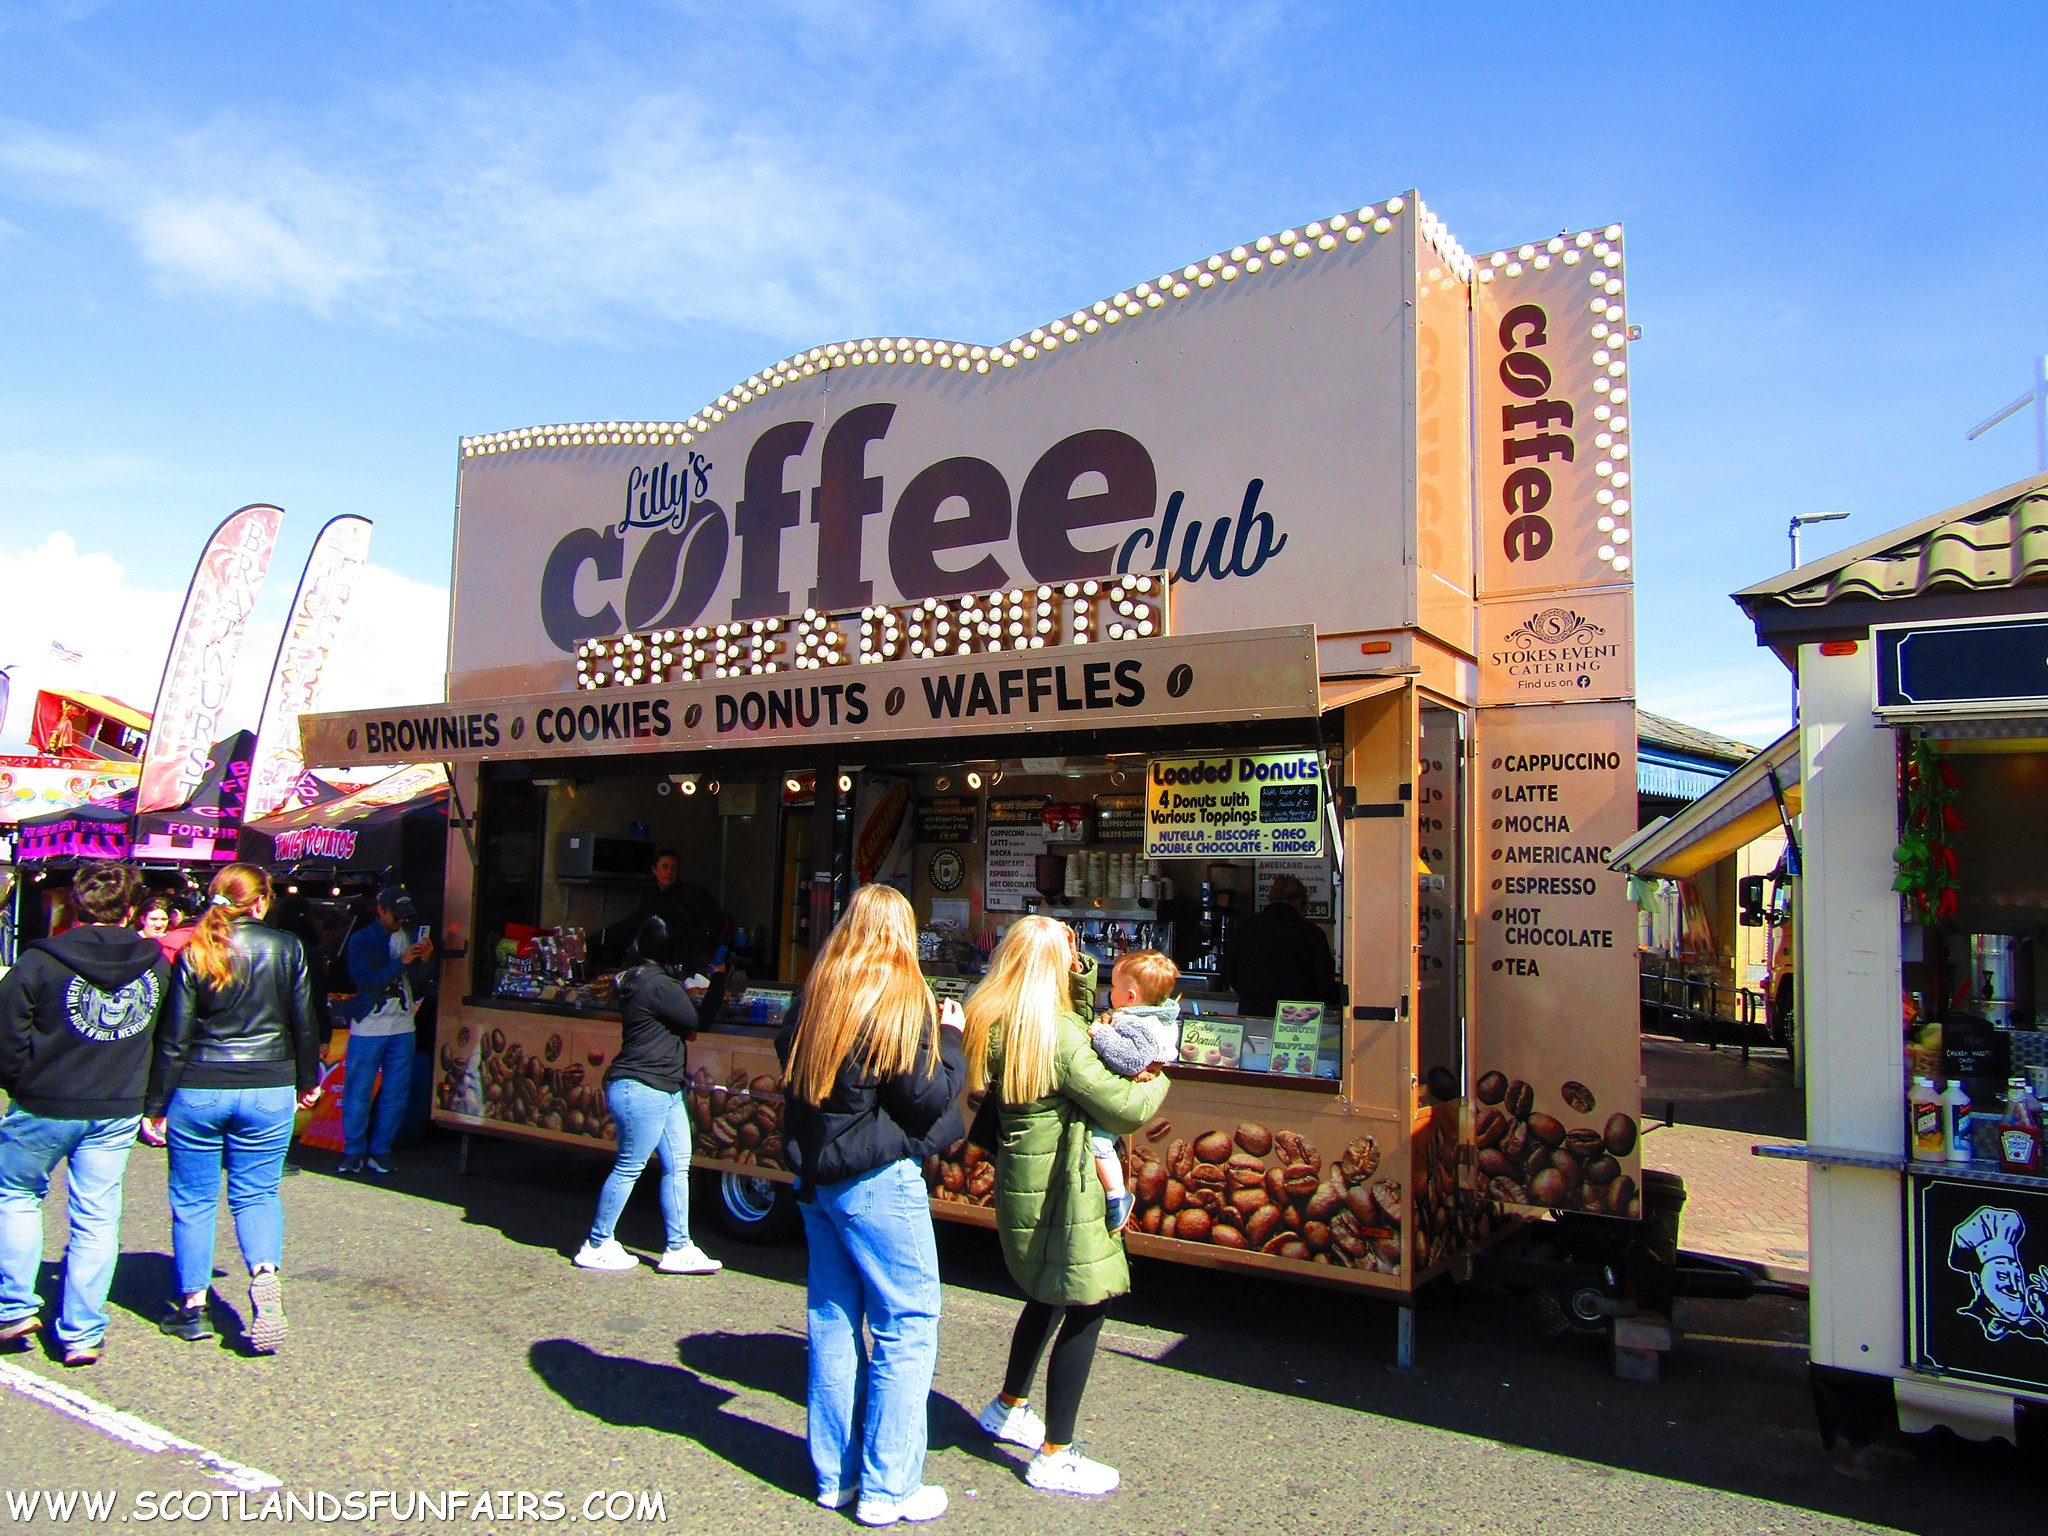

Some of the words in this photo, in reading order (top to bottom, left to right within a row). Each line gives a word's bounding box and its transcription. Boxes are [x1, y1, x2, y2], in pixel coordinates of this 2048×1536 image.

[1499, 304, 1575, 563] coffee
[618, 451, 713, 534] Lilly's
[541, 402, 1157, 654] coffee
[1116, 478, 1288, 585] club
[576, 616, 784, 691] COFFEE
[797, 607, 842, 670] &
[859, 573, 1156, 666] DONUTS
[1491, 648, 1557, 667] STOKES
[1562, 644, 1620, 660] EVENT
[1508, 660, 1601, 676] CATERING
[920, 659, 1146, 719] WAFFLES
[1518, 679, 1542, 689] Find
[1544, 680, 1557, 688] us
[1559, 679, 1573, 687] on
[714, 682, 868, 734] DONUTS
[536, 699, 672, 744] COOKIES
[366, 712, 501, 754] BROWNIES
[1504, 752, 1621, 772] CAPPUCCINO
[1153, 758, 1233, 786] Loaded
[1239, 757, 1319, 783] Donuts
[1159, 790, 1170, 809] 4
[1173, 793, 1217, 809] Donuts
[1220, 791, 1250, 808] with
[1505, 785, 1559, 802] LATTE
[1151, 809, 1196, 824] Various
[1200, 807, 1257, 827] Toppings
[1505, 815, 1571, 833] MOCHA
[167, 822, 203, 837] FOR
[990, 829, 1025, 837] CAPPUCCINO
[1159, 830, 1204, 842] NUTELLA
[1214, 829, 1260, 841] BISCOFF
[1271, 828, 1306, 840] OREO
[1151, 842, 1193, 853] DOUBLE
[1195, 841, 1261, 853] CHOCOLATE
[1272, 840, 1316, 852] KINDER
[990, 870, 1019, 878] ESPRESSO
[1258, 861, 1303, 869] AMERICANO
[989, 880, 1002, 888] HOT
[1002, 880, 1036, 888] CHOCOLATE
[1505, 877, 1597, 895] ESPRESSO
[1505, 907, 1541, 925] HOT
[1505, 927, 1613, 948] CHOCOLATE
[1505, 958, 1540, 976] TEA
[66, 973, 87, 1009] TWENTY
[69, 1012, 91, 1034] ROCK
[85, 1029, 96, 1038] N
[94, 1030, 116, 1042] ROLL
[117, 1012, 153, 1040] NERDING
[1217, 1024, 1240, 1034] made
[1277, 1025, 1317, 1034] DONUTS
[1184, 1030, 1222, 1047] Donuts
